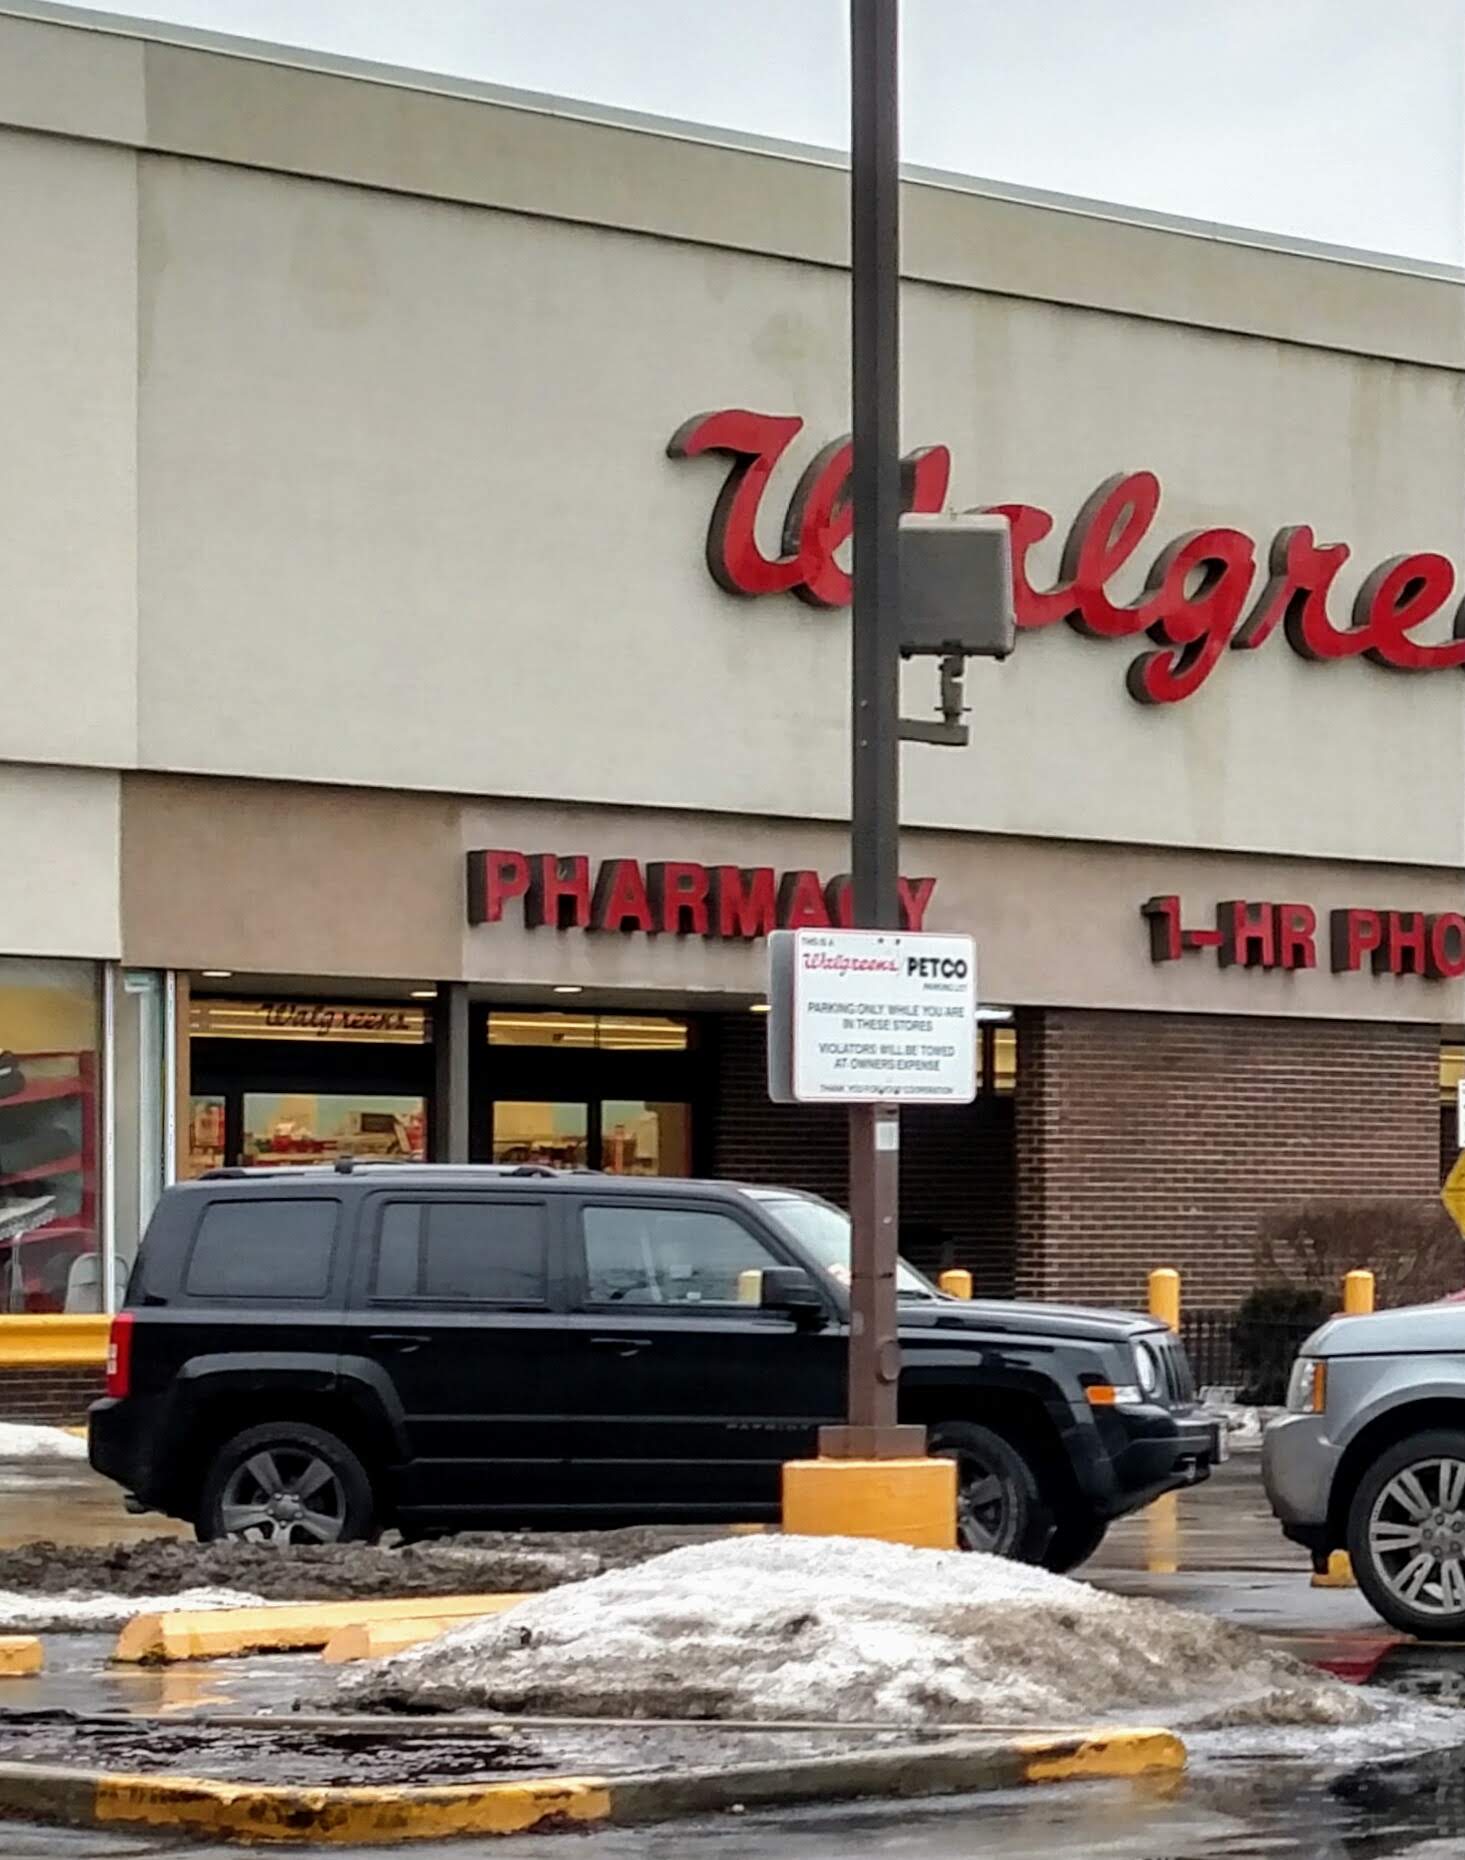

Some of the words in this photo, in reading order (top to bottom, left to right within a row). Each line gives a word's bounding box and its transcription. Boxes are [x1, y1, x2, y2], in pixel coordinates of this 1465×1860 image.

[467, 850, 937, 937] PHARMAY
[1141, 896, 1316, 968] 1-HR
[802, 952, 899, 976] Walgreens
[907, 957, 968, 979] PETCO
[256, 1003, 410, 1036] Walgreens
[808, 1002, 854, 1014] PARKING
[855, 1003, 883, 1015] ONLY
[888, 1004, 920, 1017] WHILE
[922, 1006, 943, 1018] YOU
[944, 1007, 965, 1018] ARE
[842, 1018, 854, 1030] IN
[857, 1019, 890, 1031] THESE
[893, 1020, 933, 1032] STORES
[818, 1043, 877, 1055] VIOLATORS
[880, 1044, 904, 1056] WILL
[905, 1045, 918, 1056] BE
[920, 1046, 955, 1057] TOWED
[834, 1058, 848, 1069] AT
[896, 1059, 941, 1071] EXPENSE
